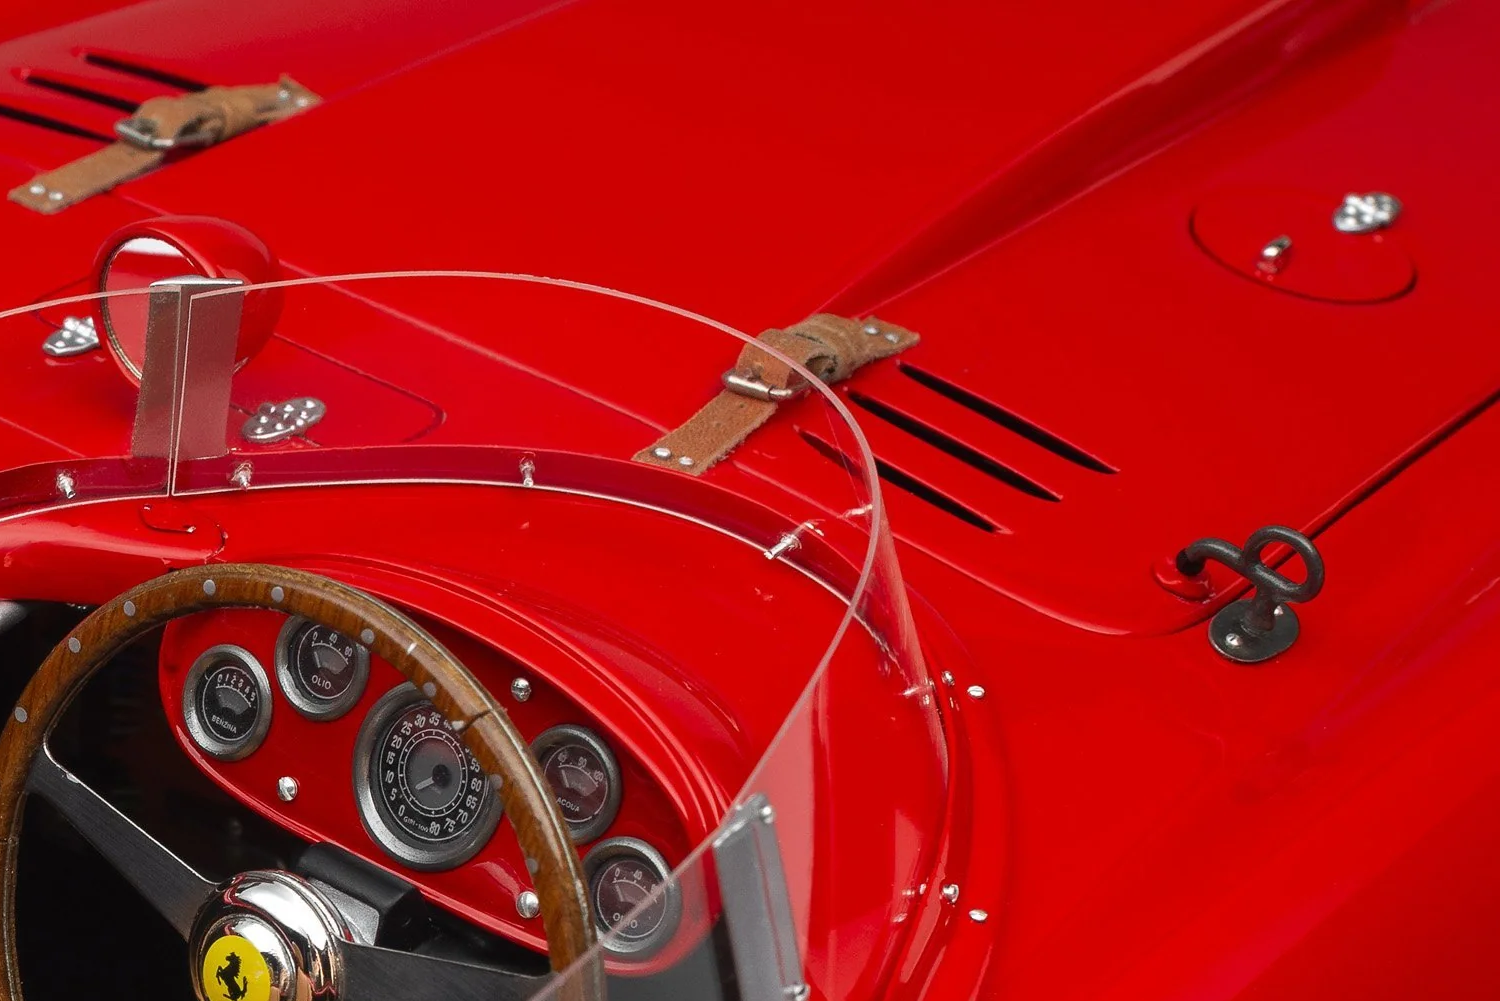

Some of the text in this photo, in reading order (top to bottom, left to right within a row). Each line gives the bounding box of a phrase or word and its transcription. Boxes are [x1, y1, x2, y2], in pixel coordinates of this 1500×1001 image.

[311, 674, 332, 690] OLIO
[211, 714, 238, 734] BENZINA
[414, 713, 427, 729] 30
[428, 711, 441, 726] 35
[401, 721, 413, 736] 25
[390, 735, 403, 749] 20
[386, 751, 396, 765] 15
[385, 770, 395, 784] 10
[470, 777, 482, 792] 60
[389, 788, 398, 801] 5
[465, 794, 478, 809] 65
[398, 804, 405, 817] 0
[556, 796, 581, 812] ACQUA
[456, 808, 469, 824] 70
[428, 821, 441, 836] 80
[443, 817, 456, 833] 75
